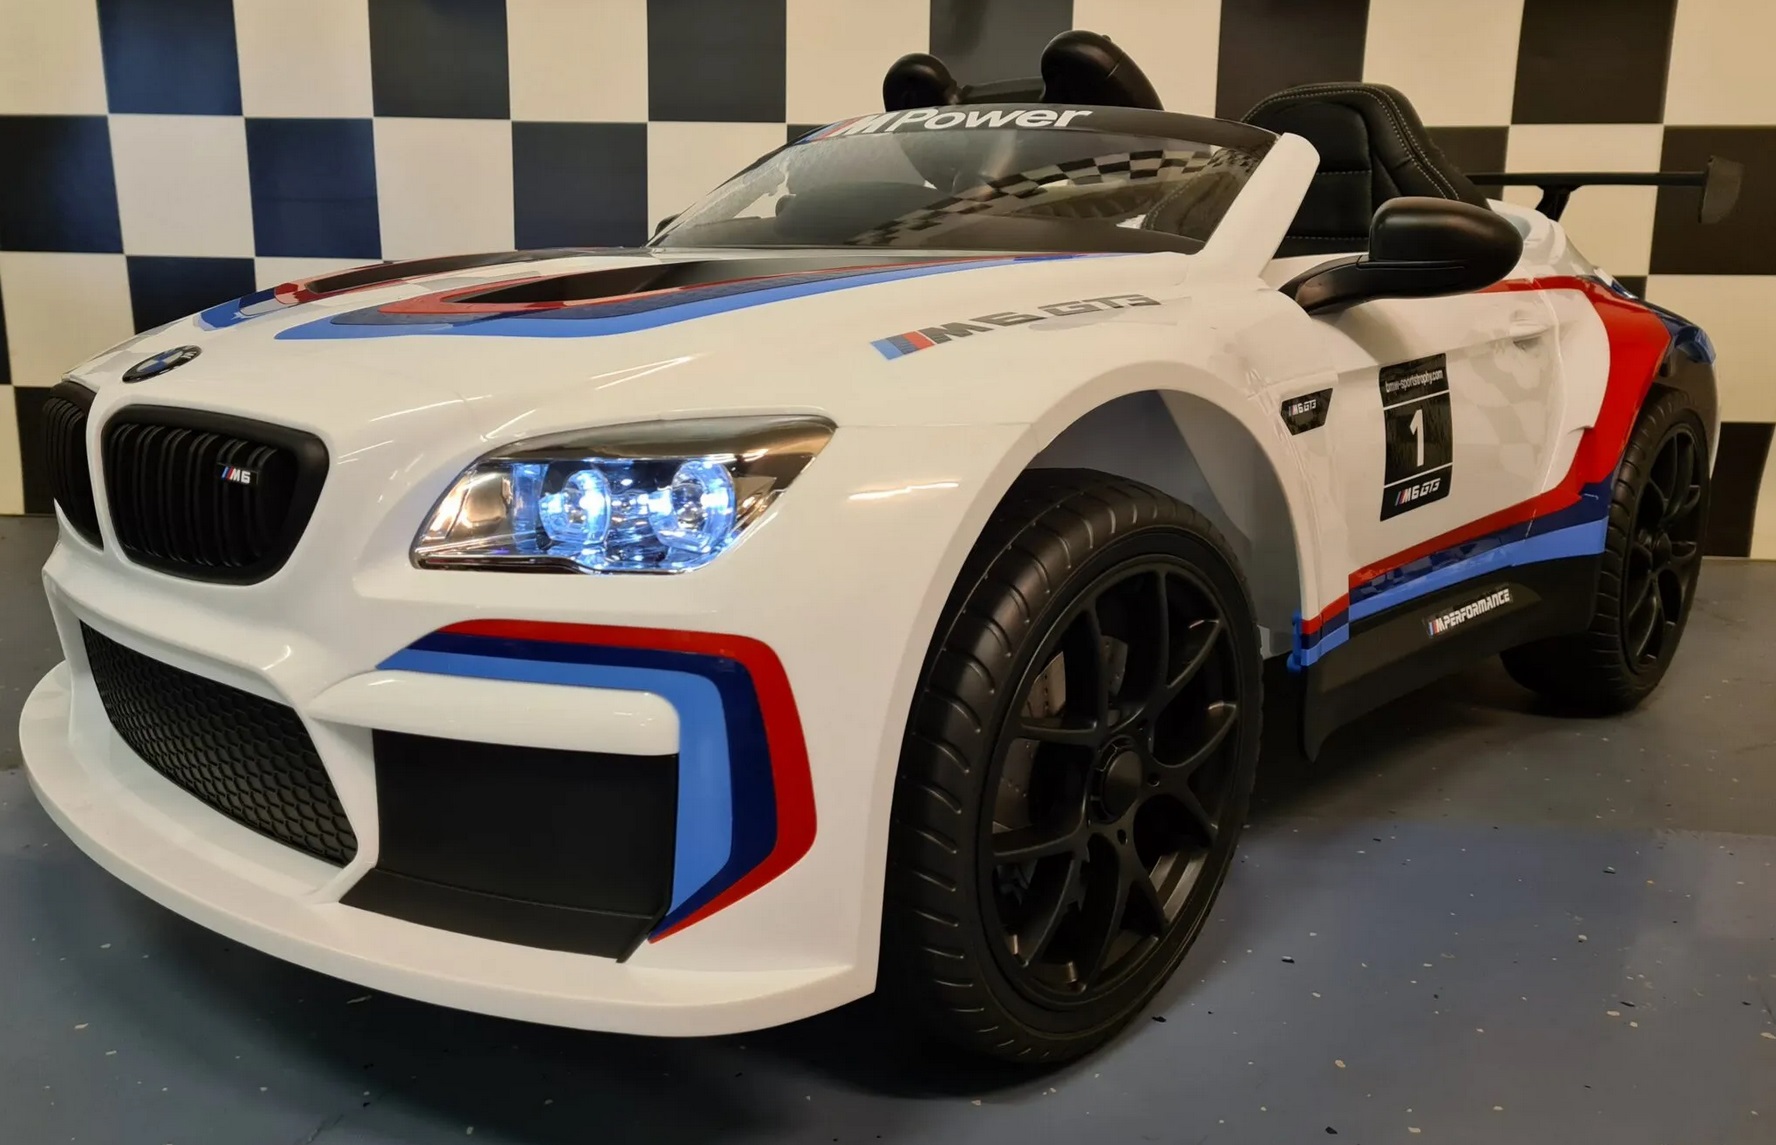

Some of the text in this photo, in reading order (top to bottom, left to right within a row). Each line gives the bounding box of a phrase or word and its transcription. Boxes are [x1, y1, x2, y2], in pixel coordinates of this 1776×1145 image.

[915, 294, 1162, 345] M6 GT3
[1409, 408, 1425, 467] 1
[229, 468, 251, 484] M6
